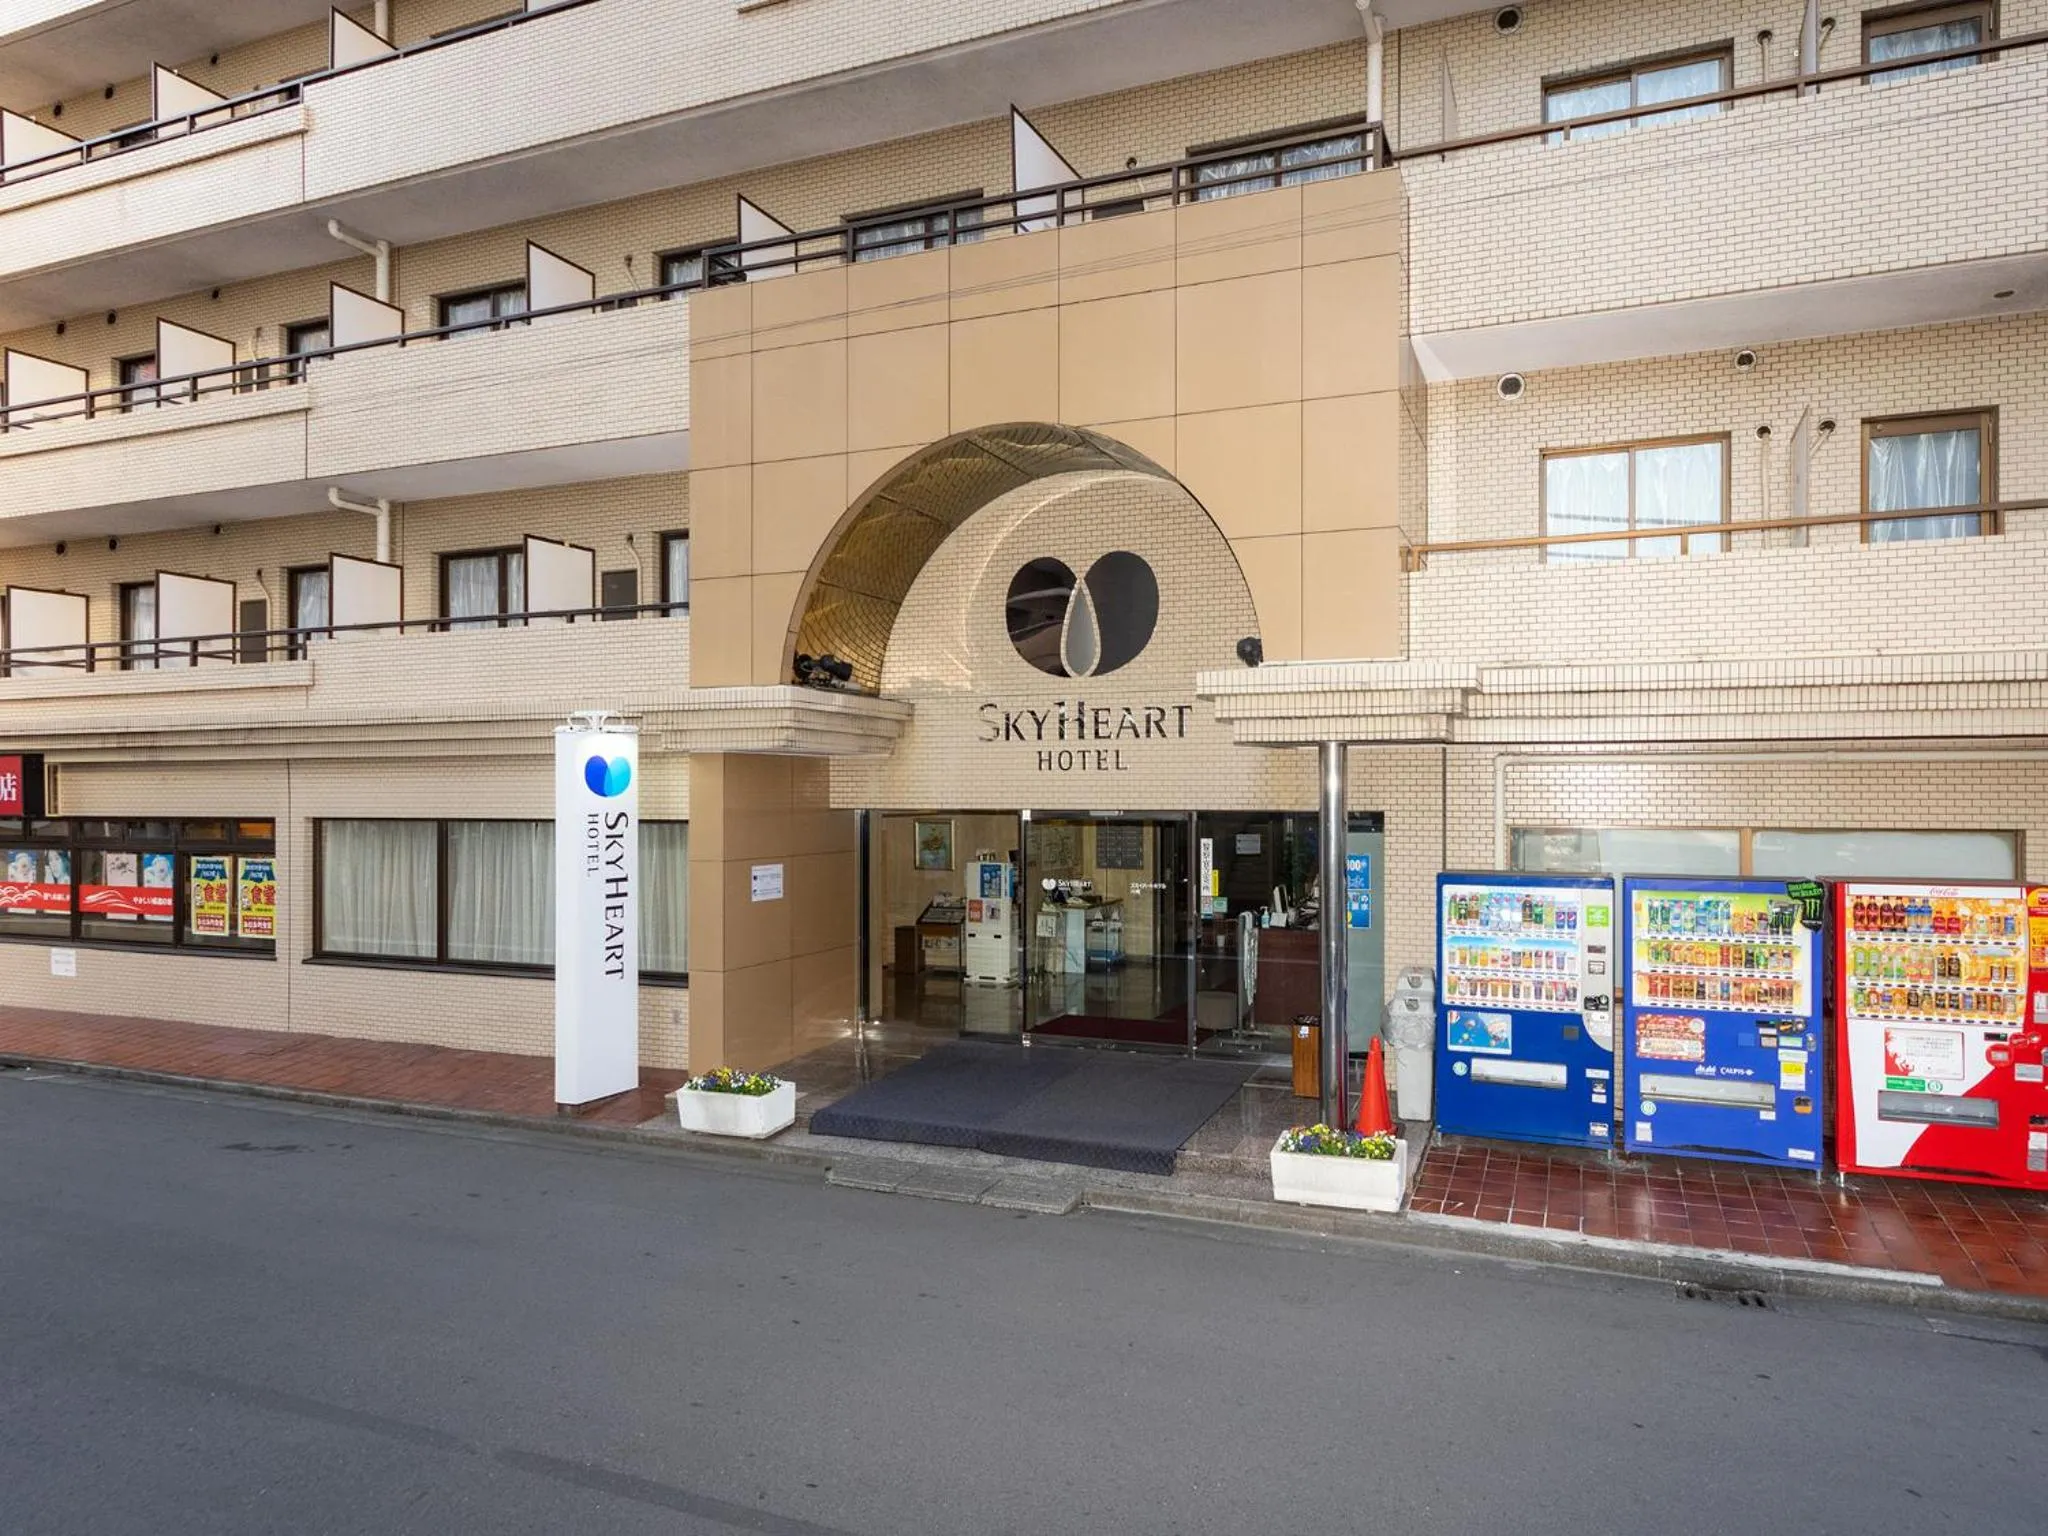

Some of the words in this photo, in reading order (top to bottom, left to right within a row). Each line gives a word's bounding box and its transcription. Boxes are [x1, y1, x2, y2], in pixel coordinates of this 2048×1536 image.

[978, 701, 1193, 742] SKYHEART
[1037, 749, 1129, 772] HOTEL
[0, 772, 17, 801] 店
[586, 813, 599, 878] HOTEL
[203, 883, 227, 904] 食堂
[251, 885, 277, 906] 食堂
[605, 811, 629, 981] SKYHEART
